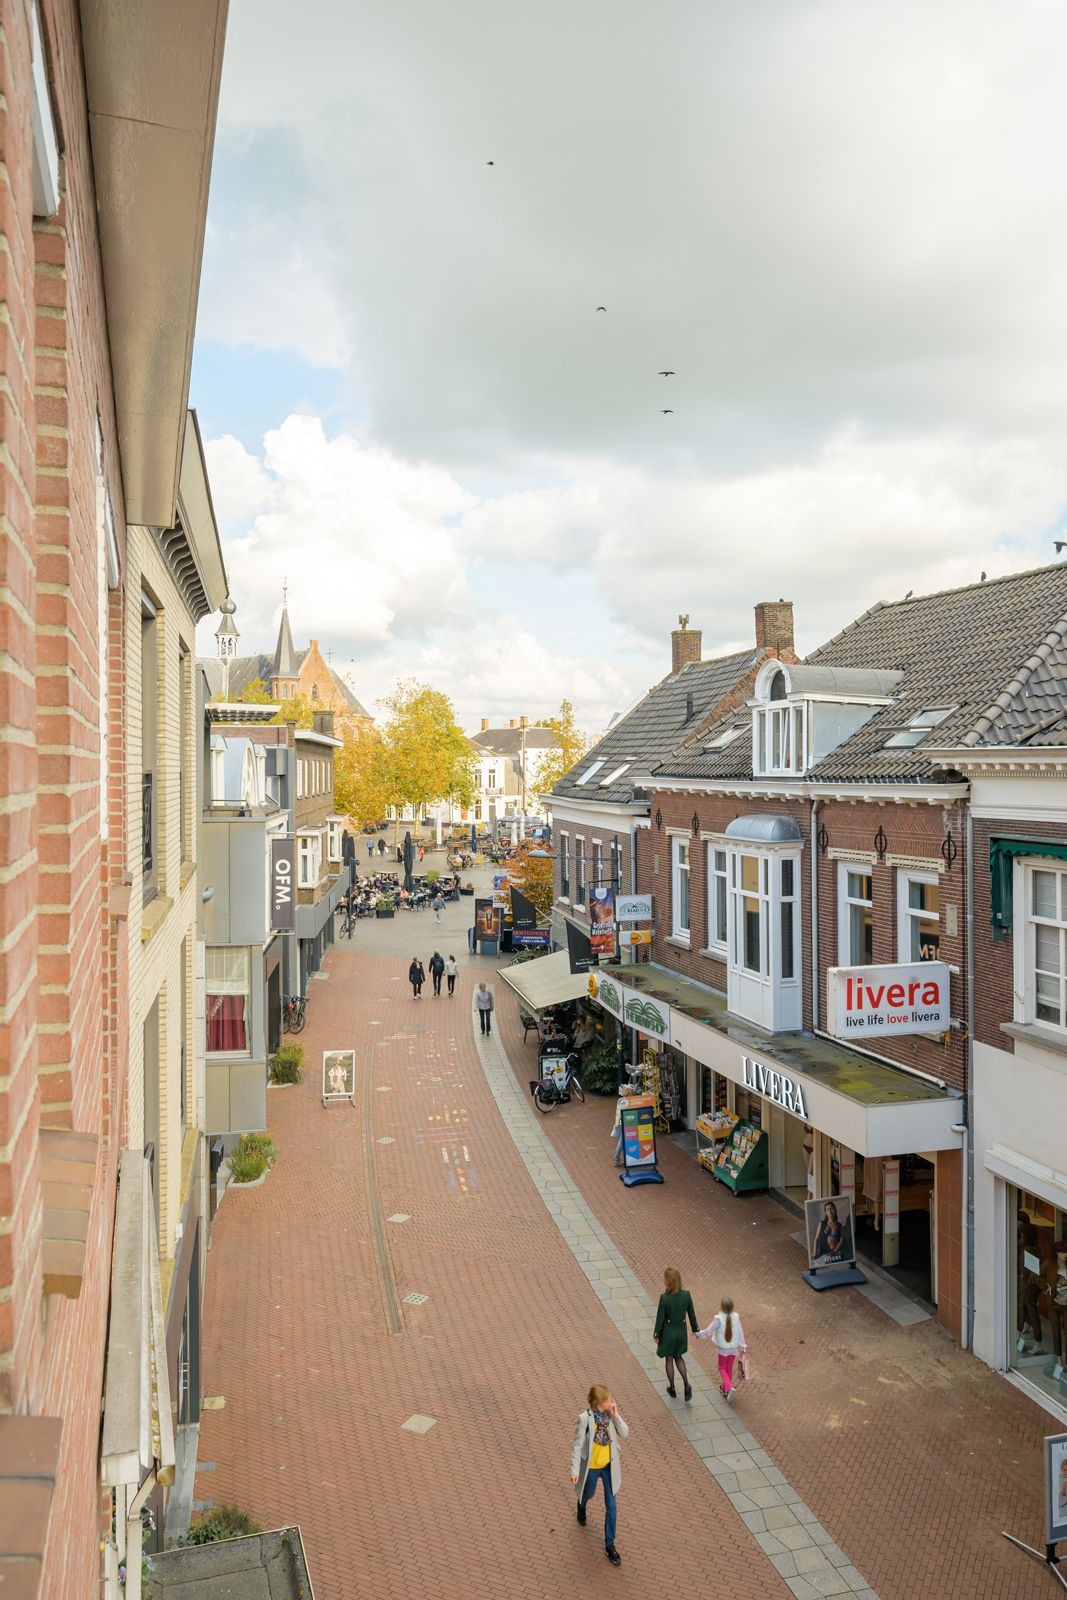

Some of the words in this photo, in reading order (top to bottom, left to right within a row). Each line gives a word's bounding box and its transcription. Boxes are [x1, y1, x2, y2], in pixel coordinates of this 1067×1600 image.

[846, 977, 940, 1011] livera
[846, 1017, 865, 1027] live
[867, 1015, 884, 1025] life
[887, 1013, 909, 1024] love
[911, 1011, 940, 1022] livera
[741, 1055, 808, 1119] LIVERA
